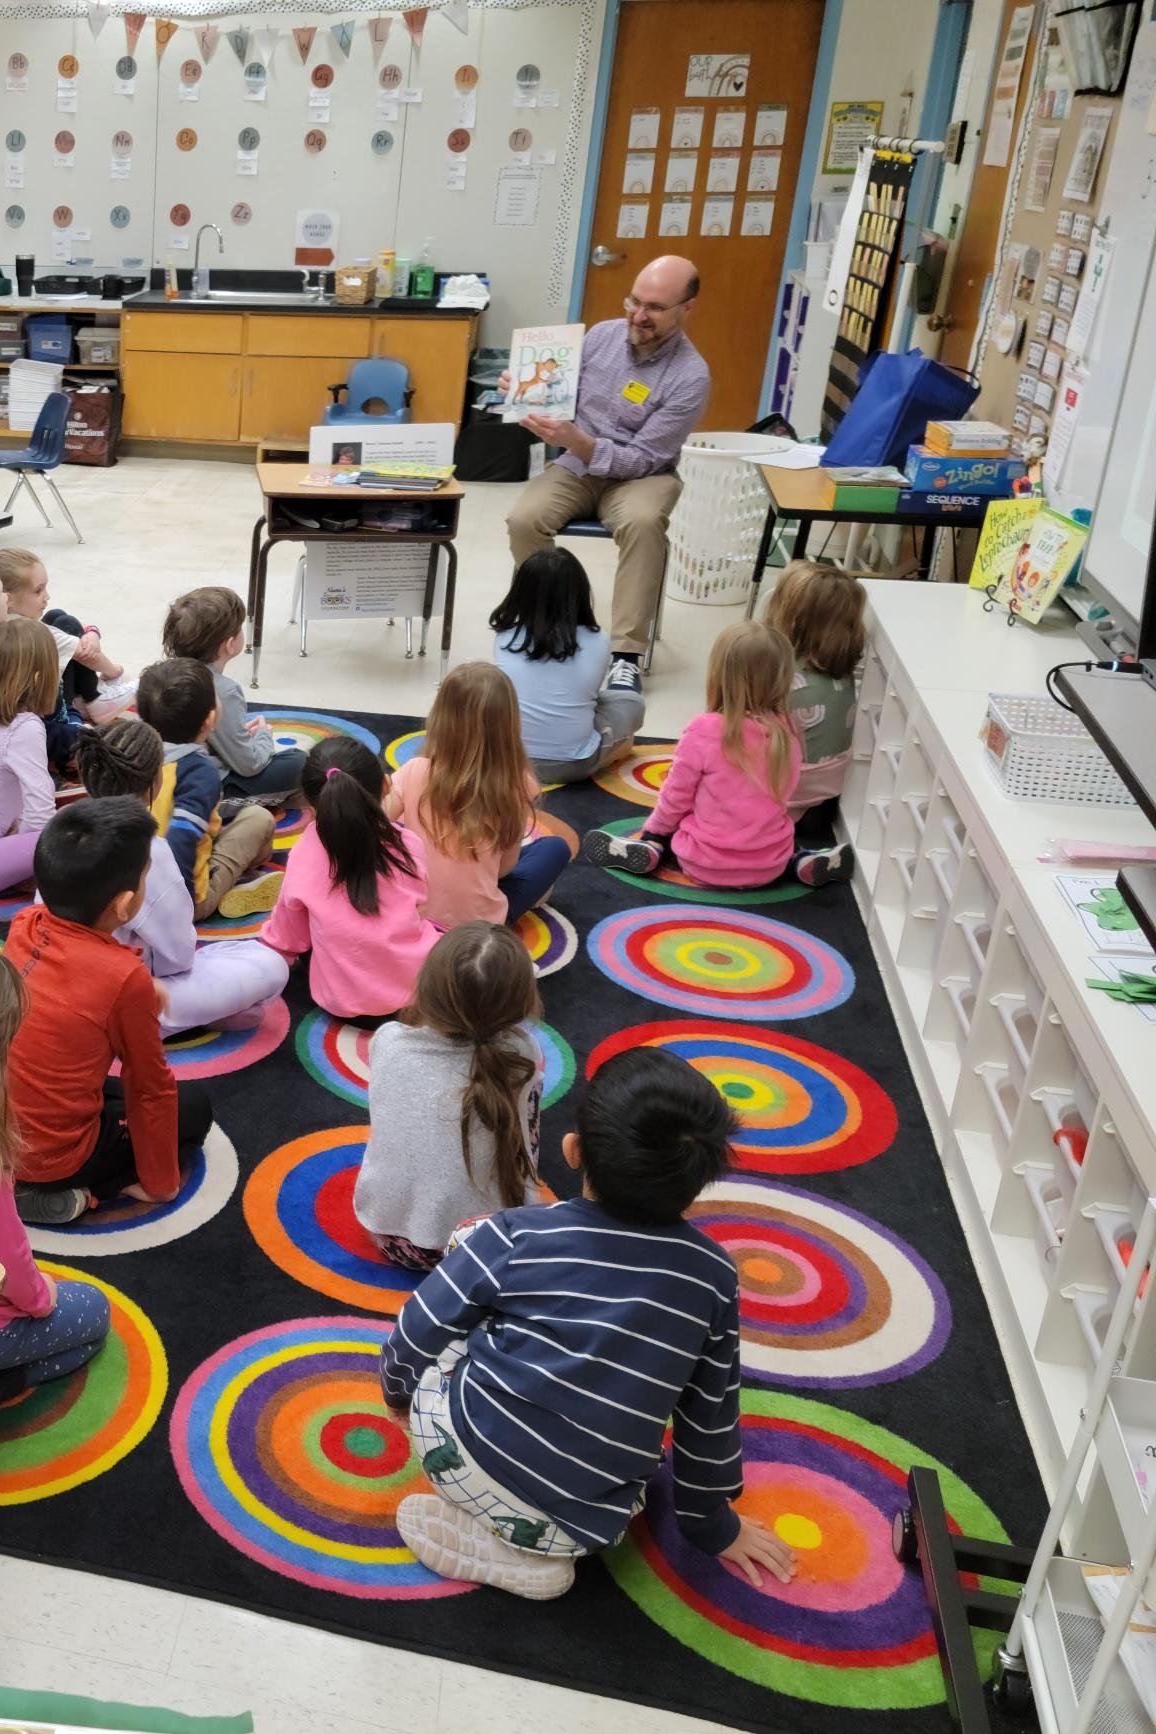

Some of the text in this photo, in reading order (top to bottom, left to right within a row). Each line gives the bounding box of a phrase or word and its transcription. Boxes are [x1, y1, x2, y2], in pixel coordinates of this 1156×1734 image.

[12, 56, 24, 69] Bb
[382, 68, 399, 83] Hh
[116, 135, 131, 147] Nn
[376, 134, 389, 147] Rr
[234, 205, 249, 220] Zz
[523, 331, 555, 343] Hello
[517, 345, 574, 371] Dog
[945, 462, 1001, 485] Zingo!
[925, 494, 981, 506] SEQUENCE
[989, 507, 1008, 530] How
